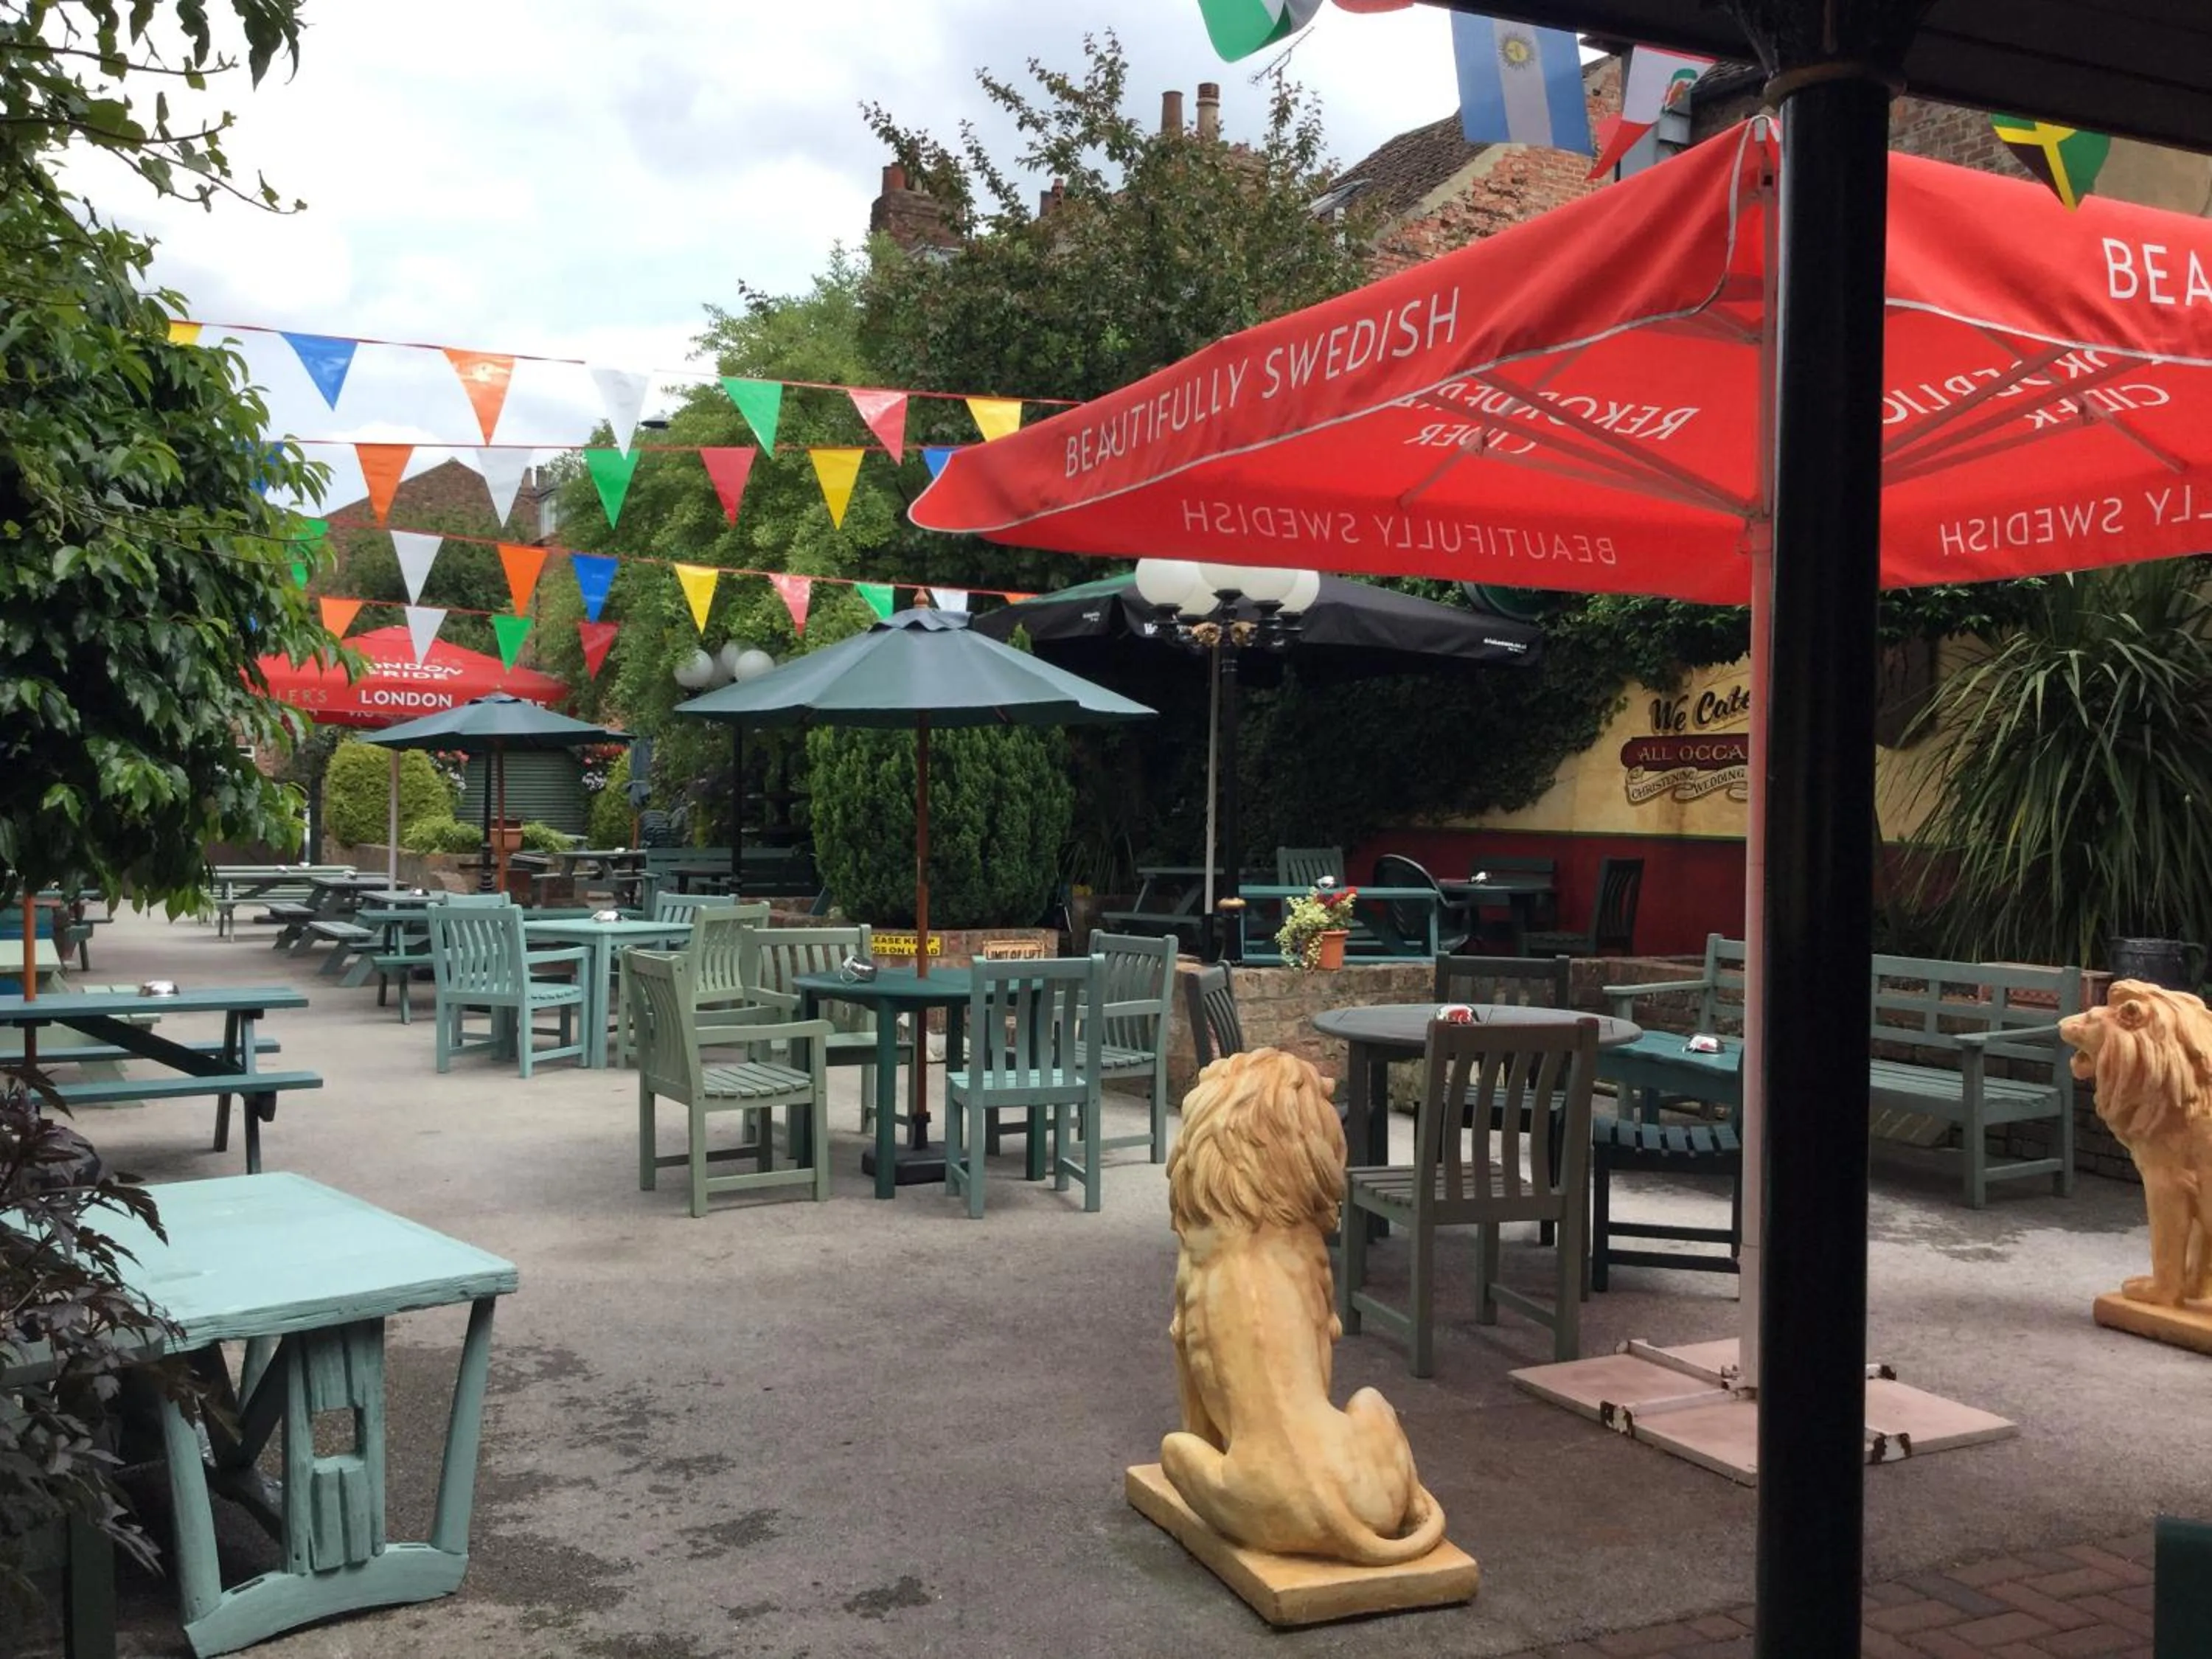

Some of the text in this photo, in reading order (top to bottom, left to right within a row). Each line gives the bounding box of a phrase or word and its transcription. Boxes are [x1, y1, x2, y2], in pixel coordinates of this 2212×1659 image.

[2102, 237, 2212, 306] BEA
[1065, 287, 1459, 478] BEAUTIFULLY SWEDISH
[364, 661, 464, 675] ONDON
[360, 689, 453, 709] LONDON
[1651, 685, 1750, 732] We Cate
[1638, 745, 1673, 762] ALL
